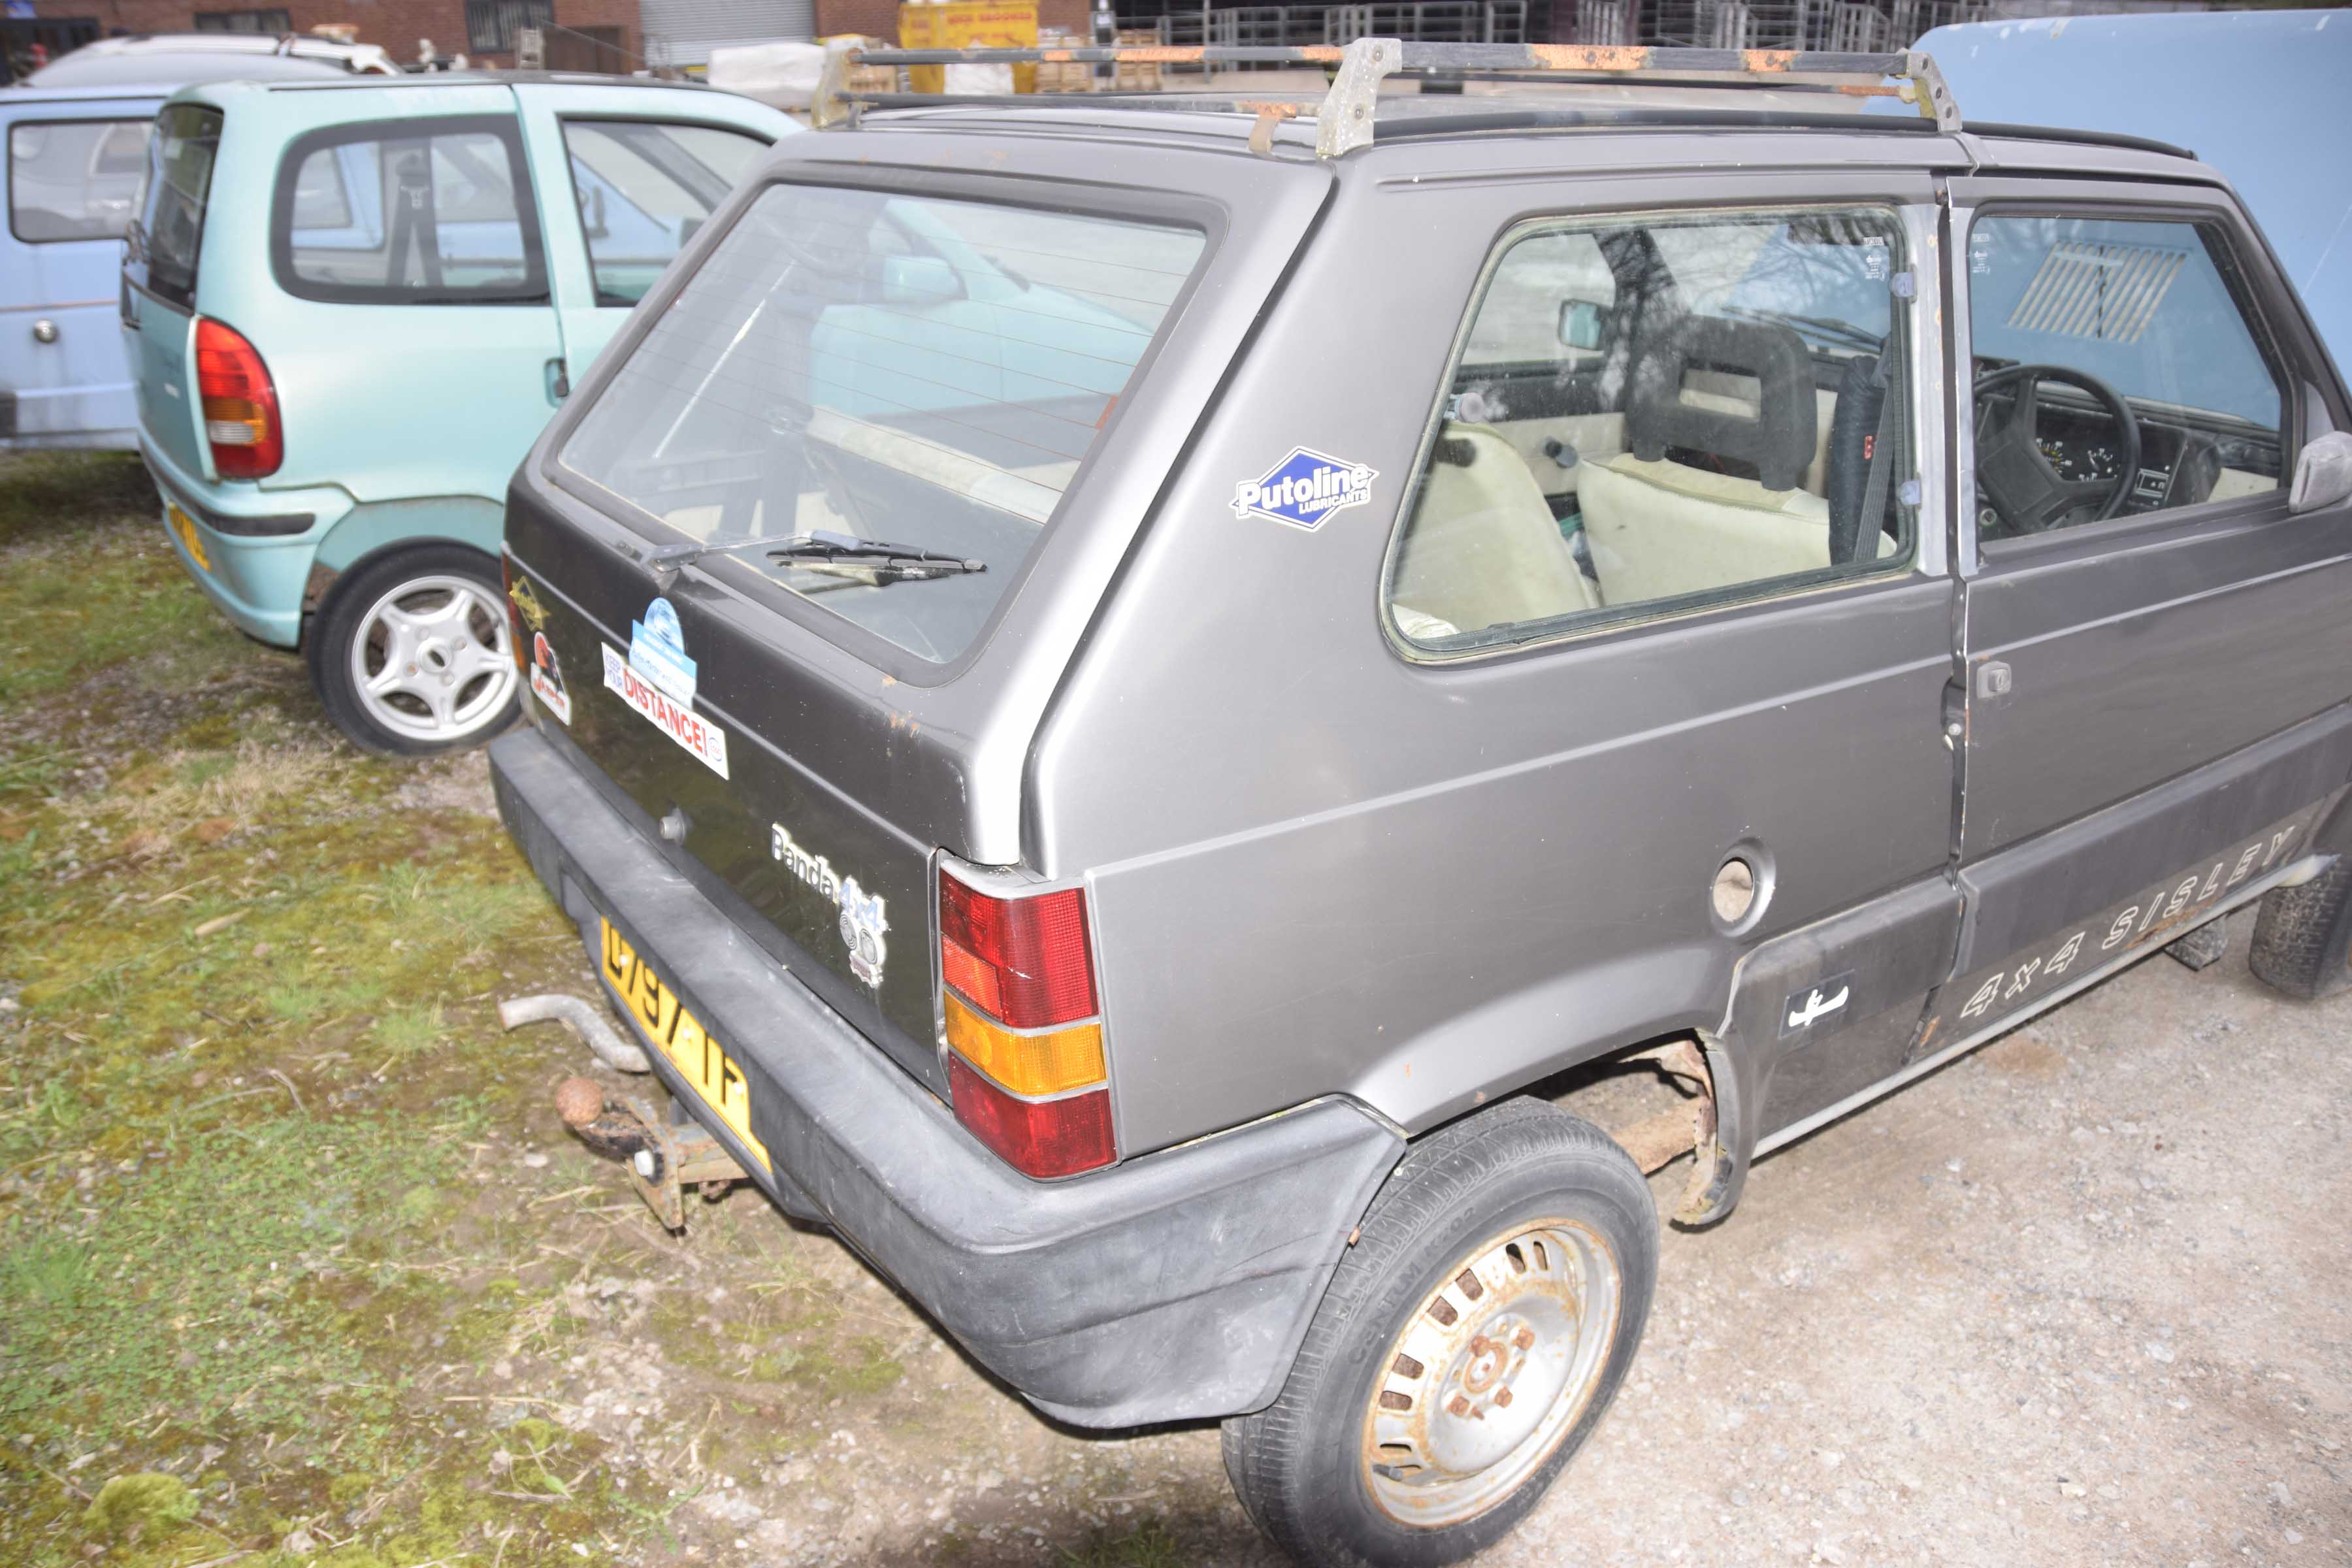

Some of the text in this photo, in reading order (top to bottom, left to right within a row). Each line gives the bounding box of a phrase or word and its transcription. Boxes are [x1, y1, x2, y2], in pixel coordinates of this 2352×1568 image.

[1238, 466, 1369, 516] Putoline
[1299, 489, 1368, 515] LUBRICANTS
[623, 666, 708, 758] DISTANCE!
[771, 825, 885, 933] Panda 4x4
[1960, 825, 2295, 1019] 4x4 SISLEY
